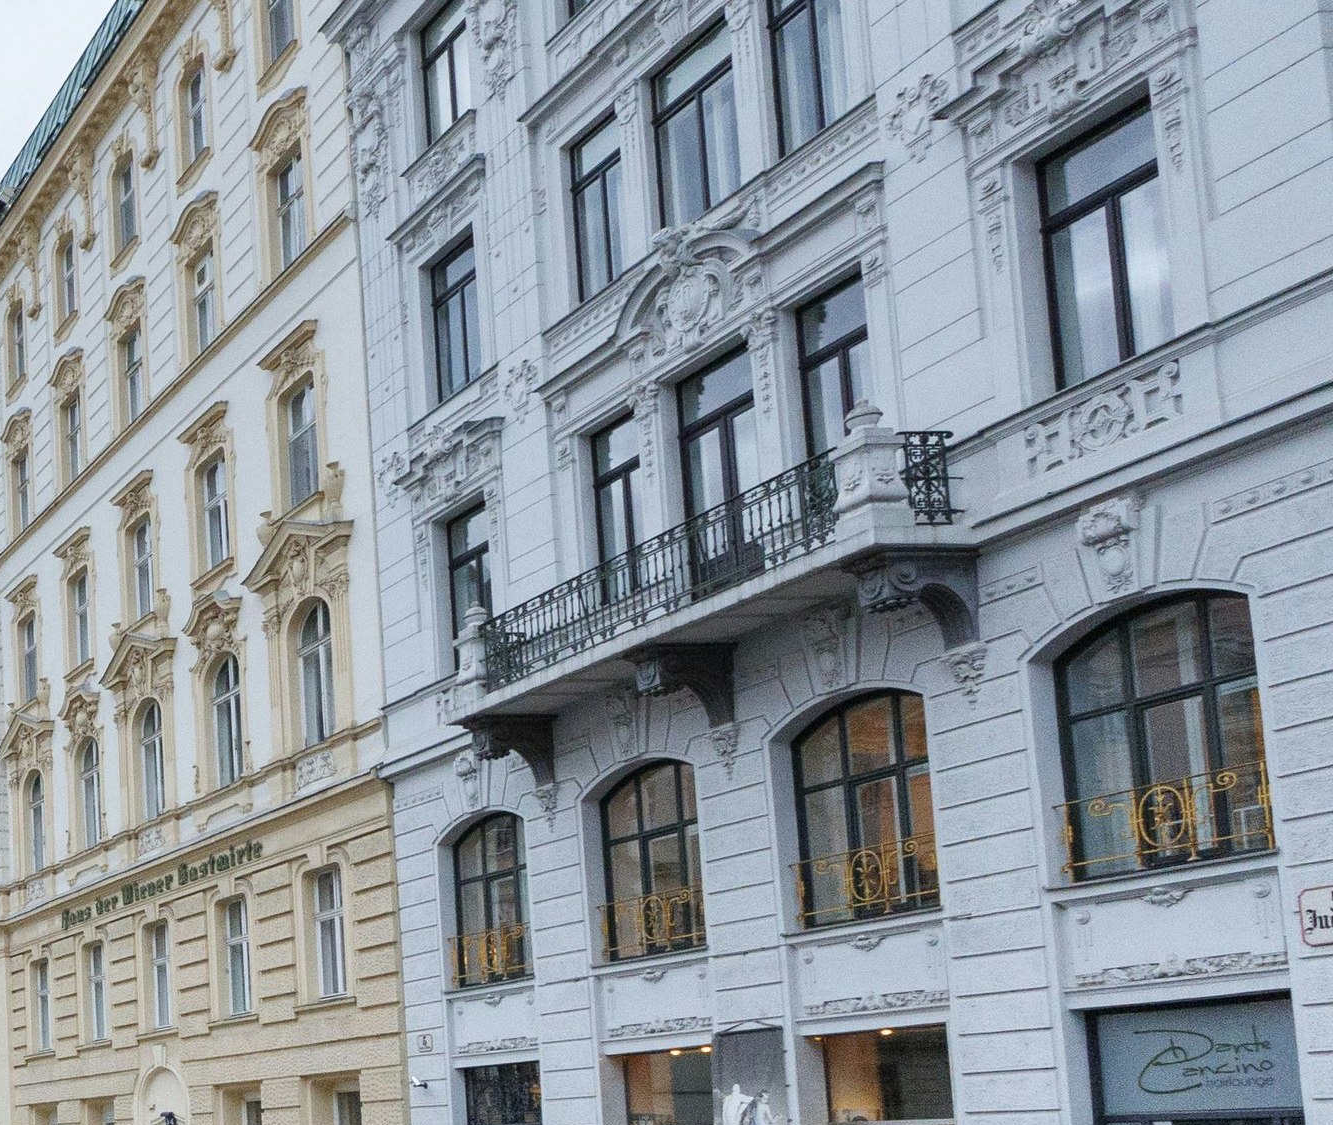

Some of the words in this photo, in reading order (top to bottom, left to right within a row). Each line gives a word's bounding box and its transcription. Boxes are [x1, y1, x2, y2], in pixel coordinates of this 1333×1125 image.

[61, 907, 92, 931] Haus
[95, 894, 118, 916] der
[120, 873, 174, 906] Wiener
[178, 839, 264, 886] Gastwirte
[1133, 1024, 1271, 1066] Dante
[1138, 1046, 1274, 1094] Cancino
